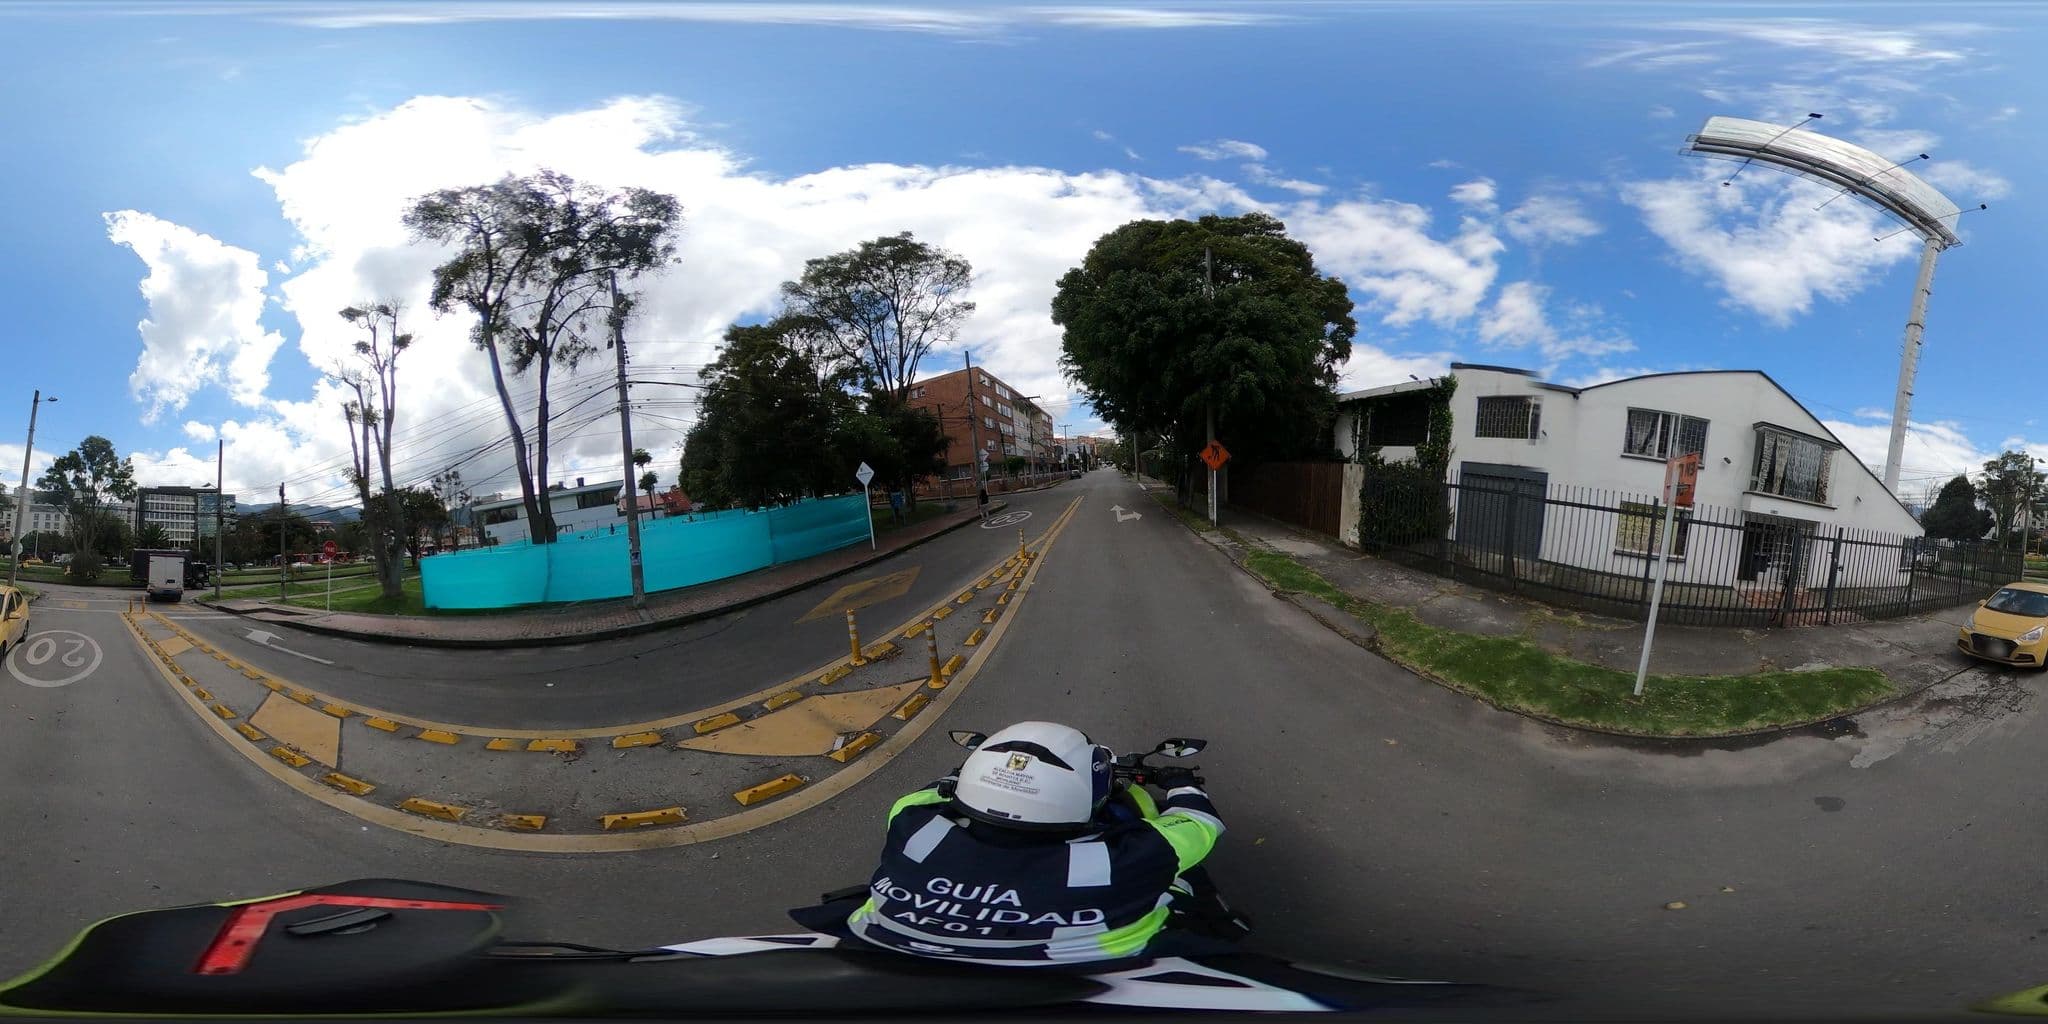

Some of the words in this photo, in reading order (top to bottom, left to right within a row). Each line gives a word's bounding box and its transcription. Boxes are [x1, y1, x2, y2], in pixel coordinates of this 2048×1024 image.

[26, 638, 85, 667] 20
[874, 877, 1105, 925] MOVILIDAD
[926, 877, 1022, 907] GUÍA
